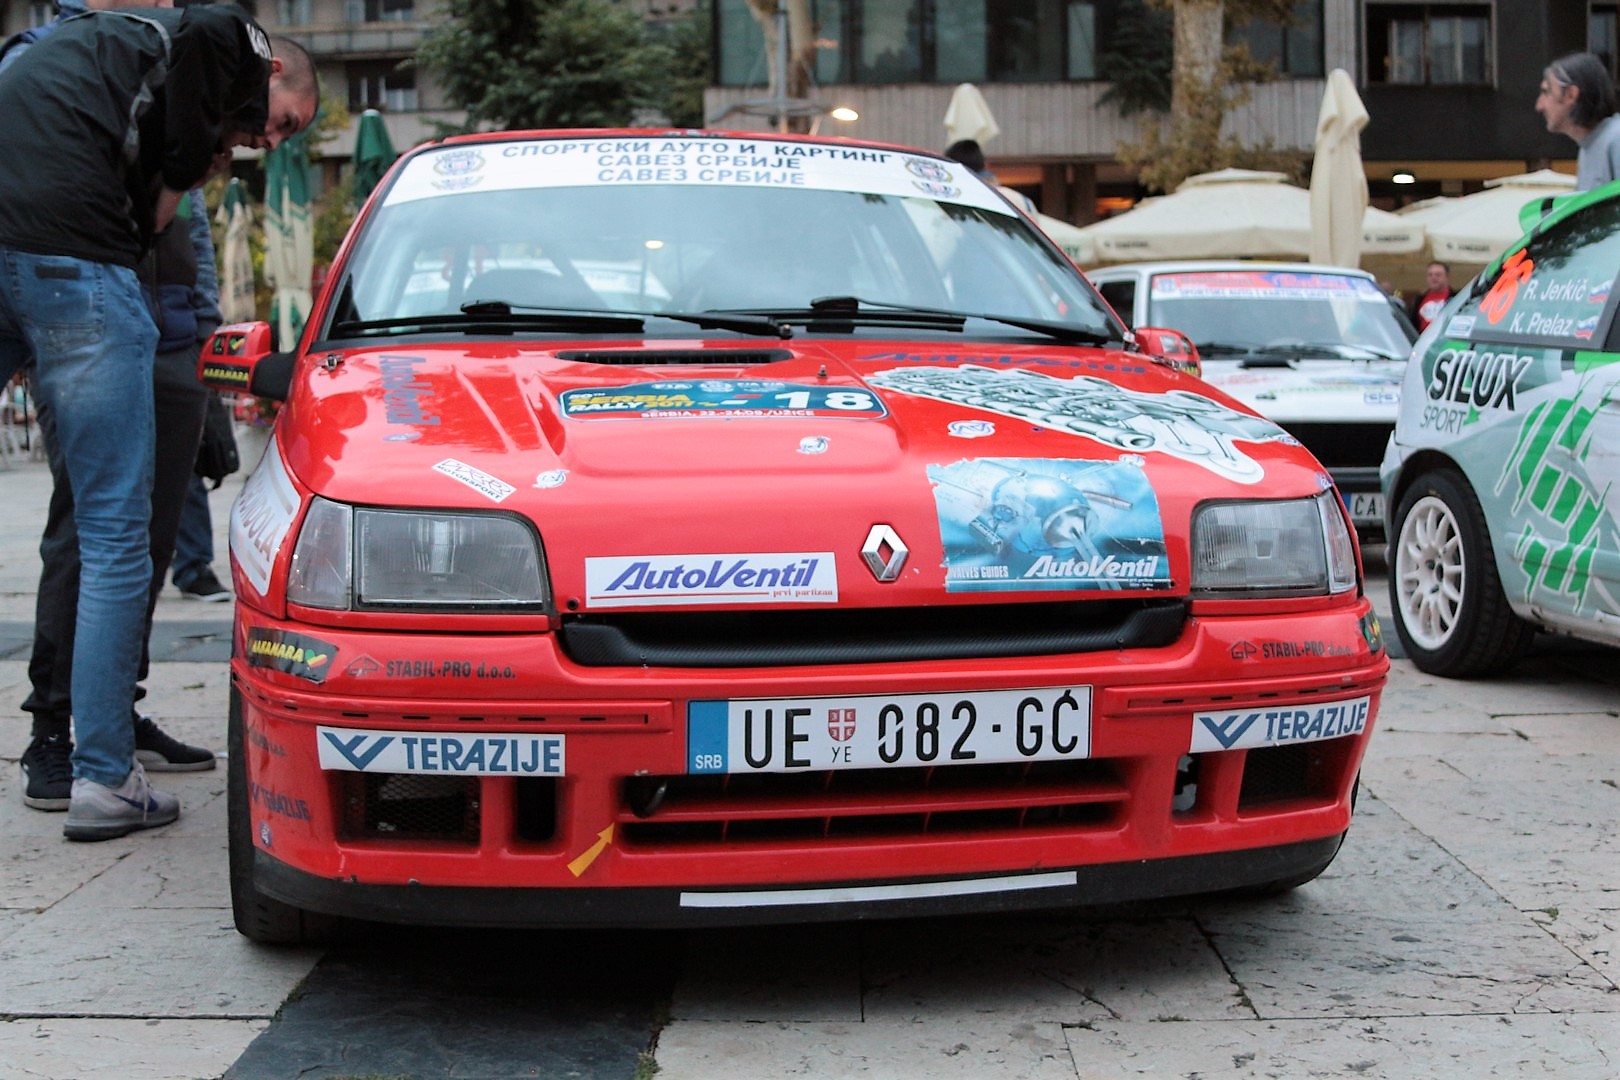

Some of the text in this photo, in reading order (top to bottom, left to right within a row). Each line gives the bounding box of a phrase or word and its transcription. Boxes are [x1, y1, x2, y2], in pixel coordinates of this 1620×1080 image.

[502, 142, 892, 164] СПОРТСКИ АУТО И КАРТИНГ
[598, 154, 801, 169] САВЕЗ СРБИЈЕ
[597, 169, 805, 185] САВЕЗ СРБИЈЕ
[1522, 279, 1538, 300] R.
[1509, 311, 1574, 336] K. Prelaz
[1428, 348, 1534, 412] SILUX
[568, 394, 692, 406] SERBIA
[568, 402, 644, 412] RALLY
[774, 391, 874, 411] 18
[1420, 405, 1467, 434] SPORT
[1355, 495, 1376, 516] CA
[604, 558, 819, 592] AutoVentil
[981, 565, 1009, 578] GUIDES
[1024, 555, 1159, 578] AutoVentil
[773, 587, 833, 598] prvi partizan
[477, 662, 516, 679] d.o.o.
[1265, 701, 1368, 742] TERAZIJE
[744, 707, 812, 770] UE
[401, 736, 561, 774] TERAZIJE
[695, 755, 723, 770] SRB
